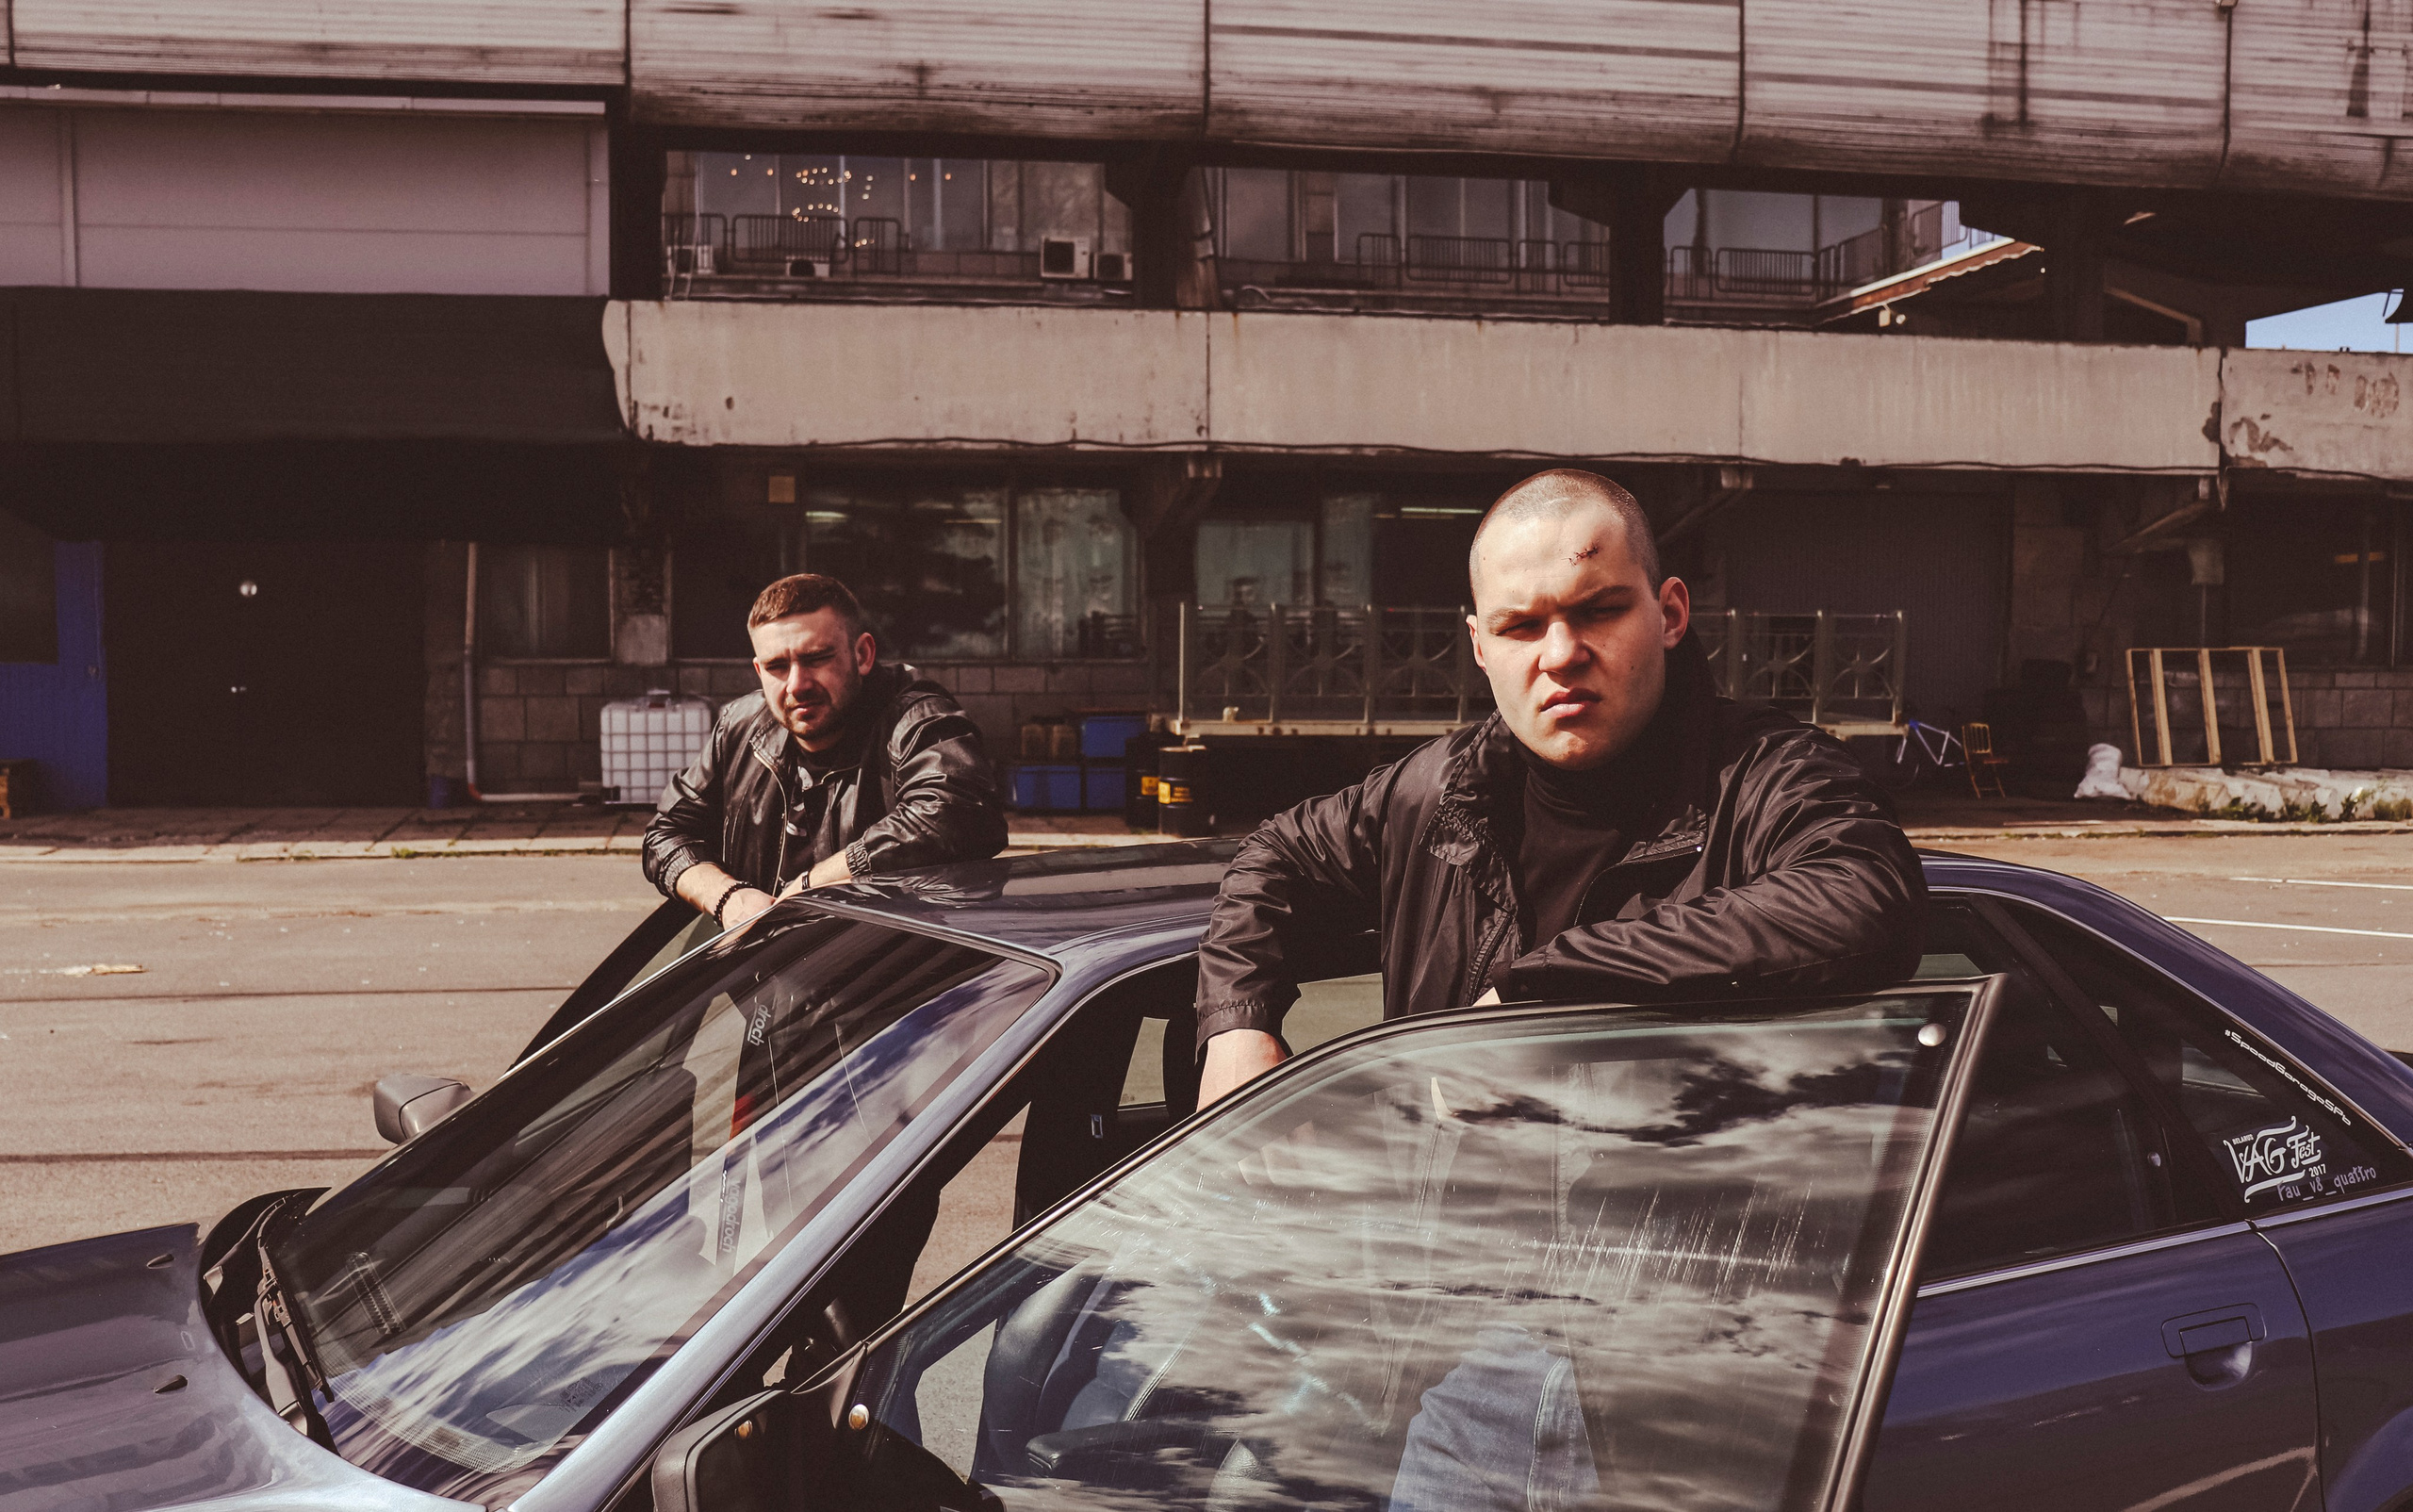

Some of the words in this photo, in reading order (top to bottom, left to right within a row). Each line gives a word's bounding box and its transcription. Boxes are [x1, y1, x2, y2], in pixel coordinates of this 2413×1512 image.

[2231, 1133, 2255, 1145] BELARUS
[2223, 1129, 2288, 1184] VAG
[2286, 1126, 2322, 1169] Fest
[2308, 1163, 2327, 1177] 2017
